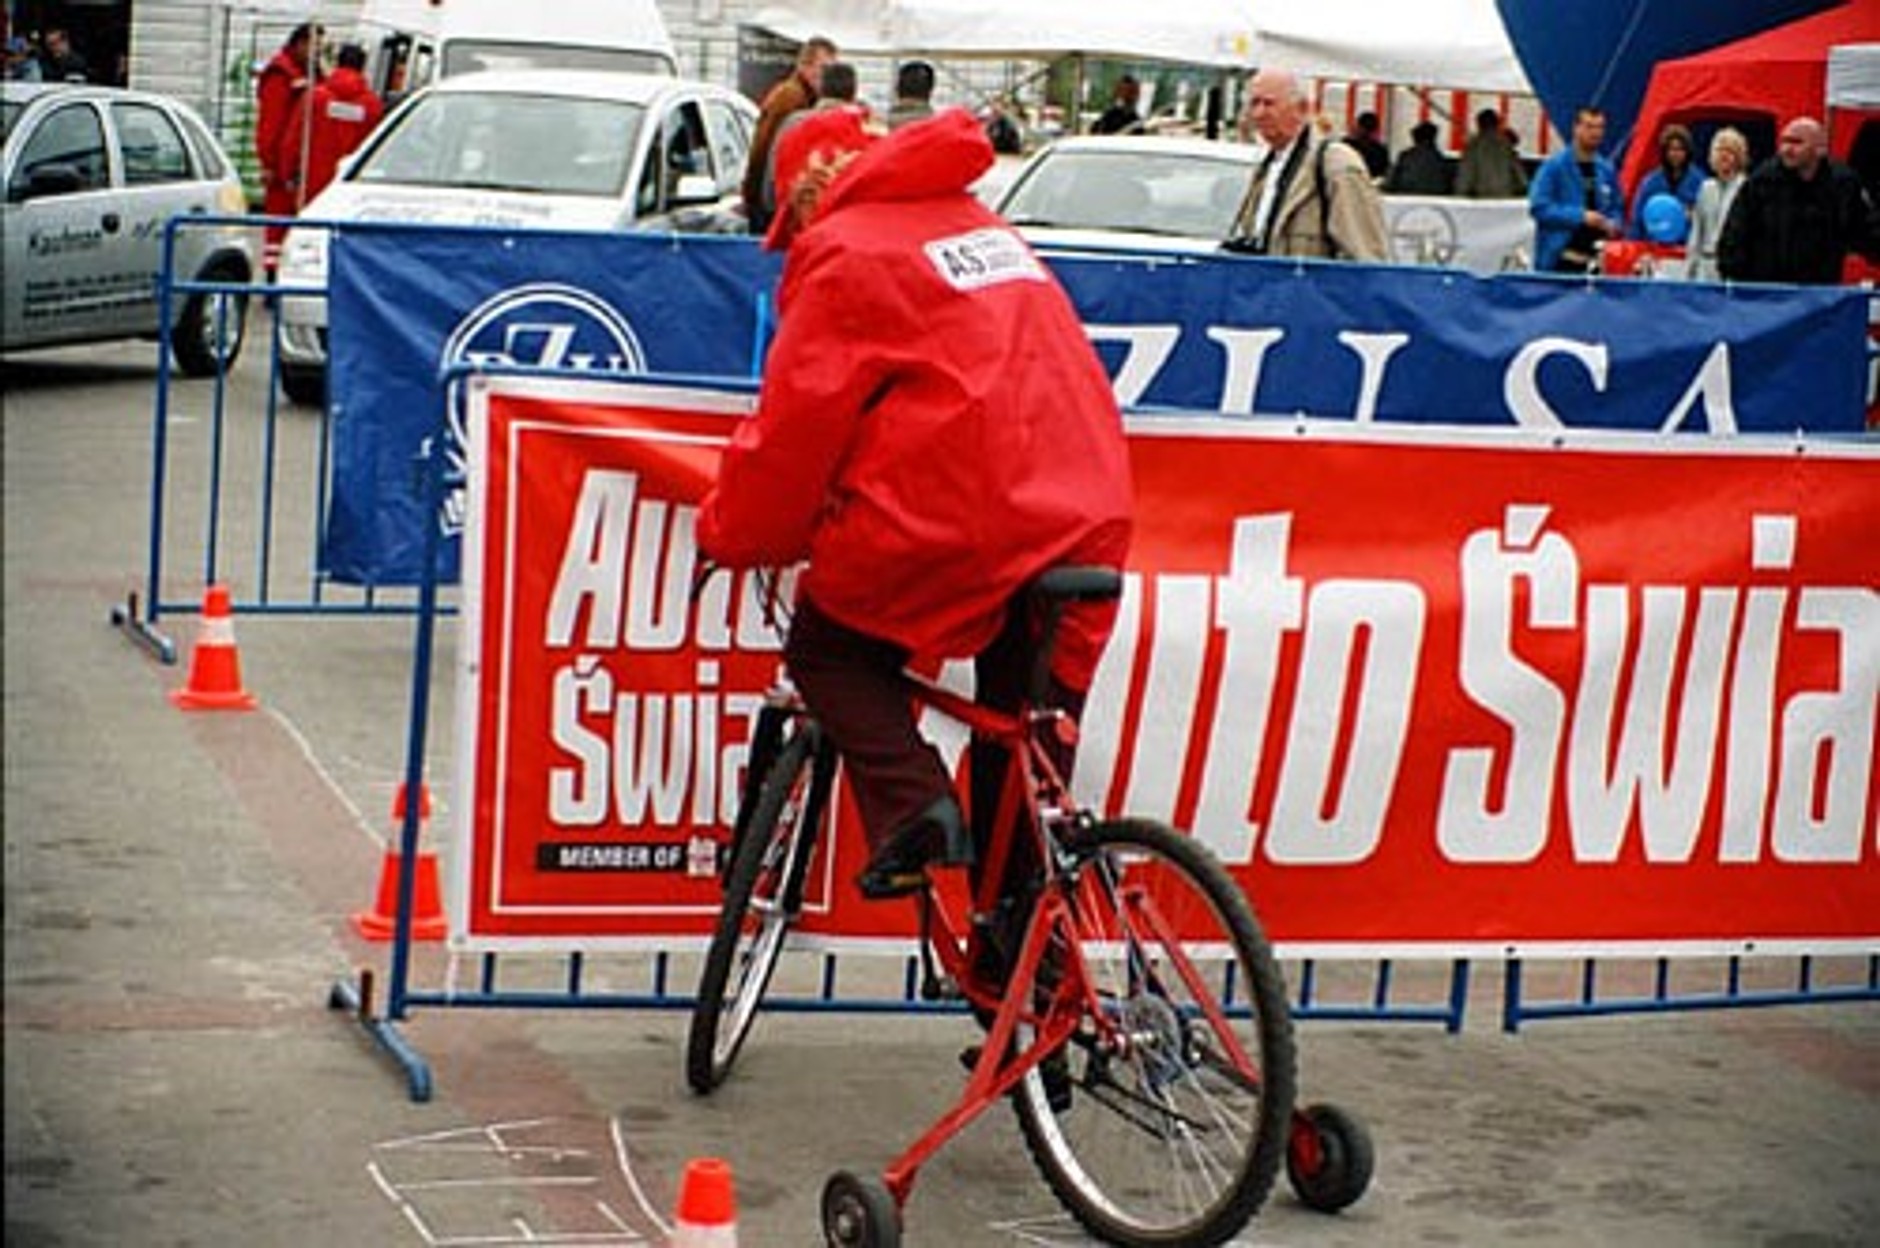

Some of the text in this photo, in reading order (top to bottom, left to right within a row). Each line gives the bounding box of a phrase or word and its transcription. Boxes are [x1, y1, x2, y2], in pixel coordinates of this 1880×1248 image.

[941, 244, 986, 279] AS
[917, 504, 1880, 865] uto Świa
[548, 656, 763, 825] Świa
[560, 846, 682, 867] MEMBER OF
